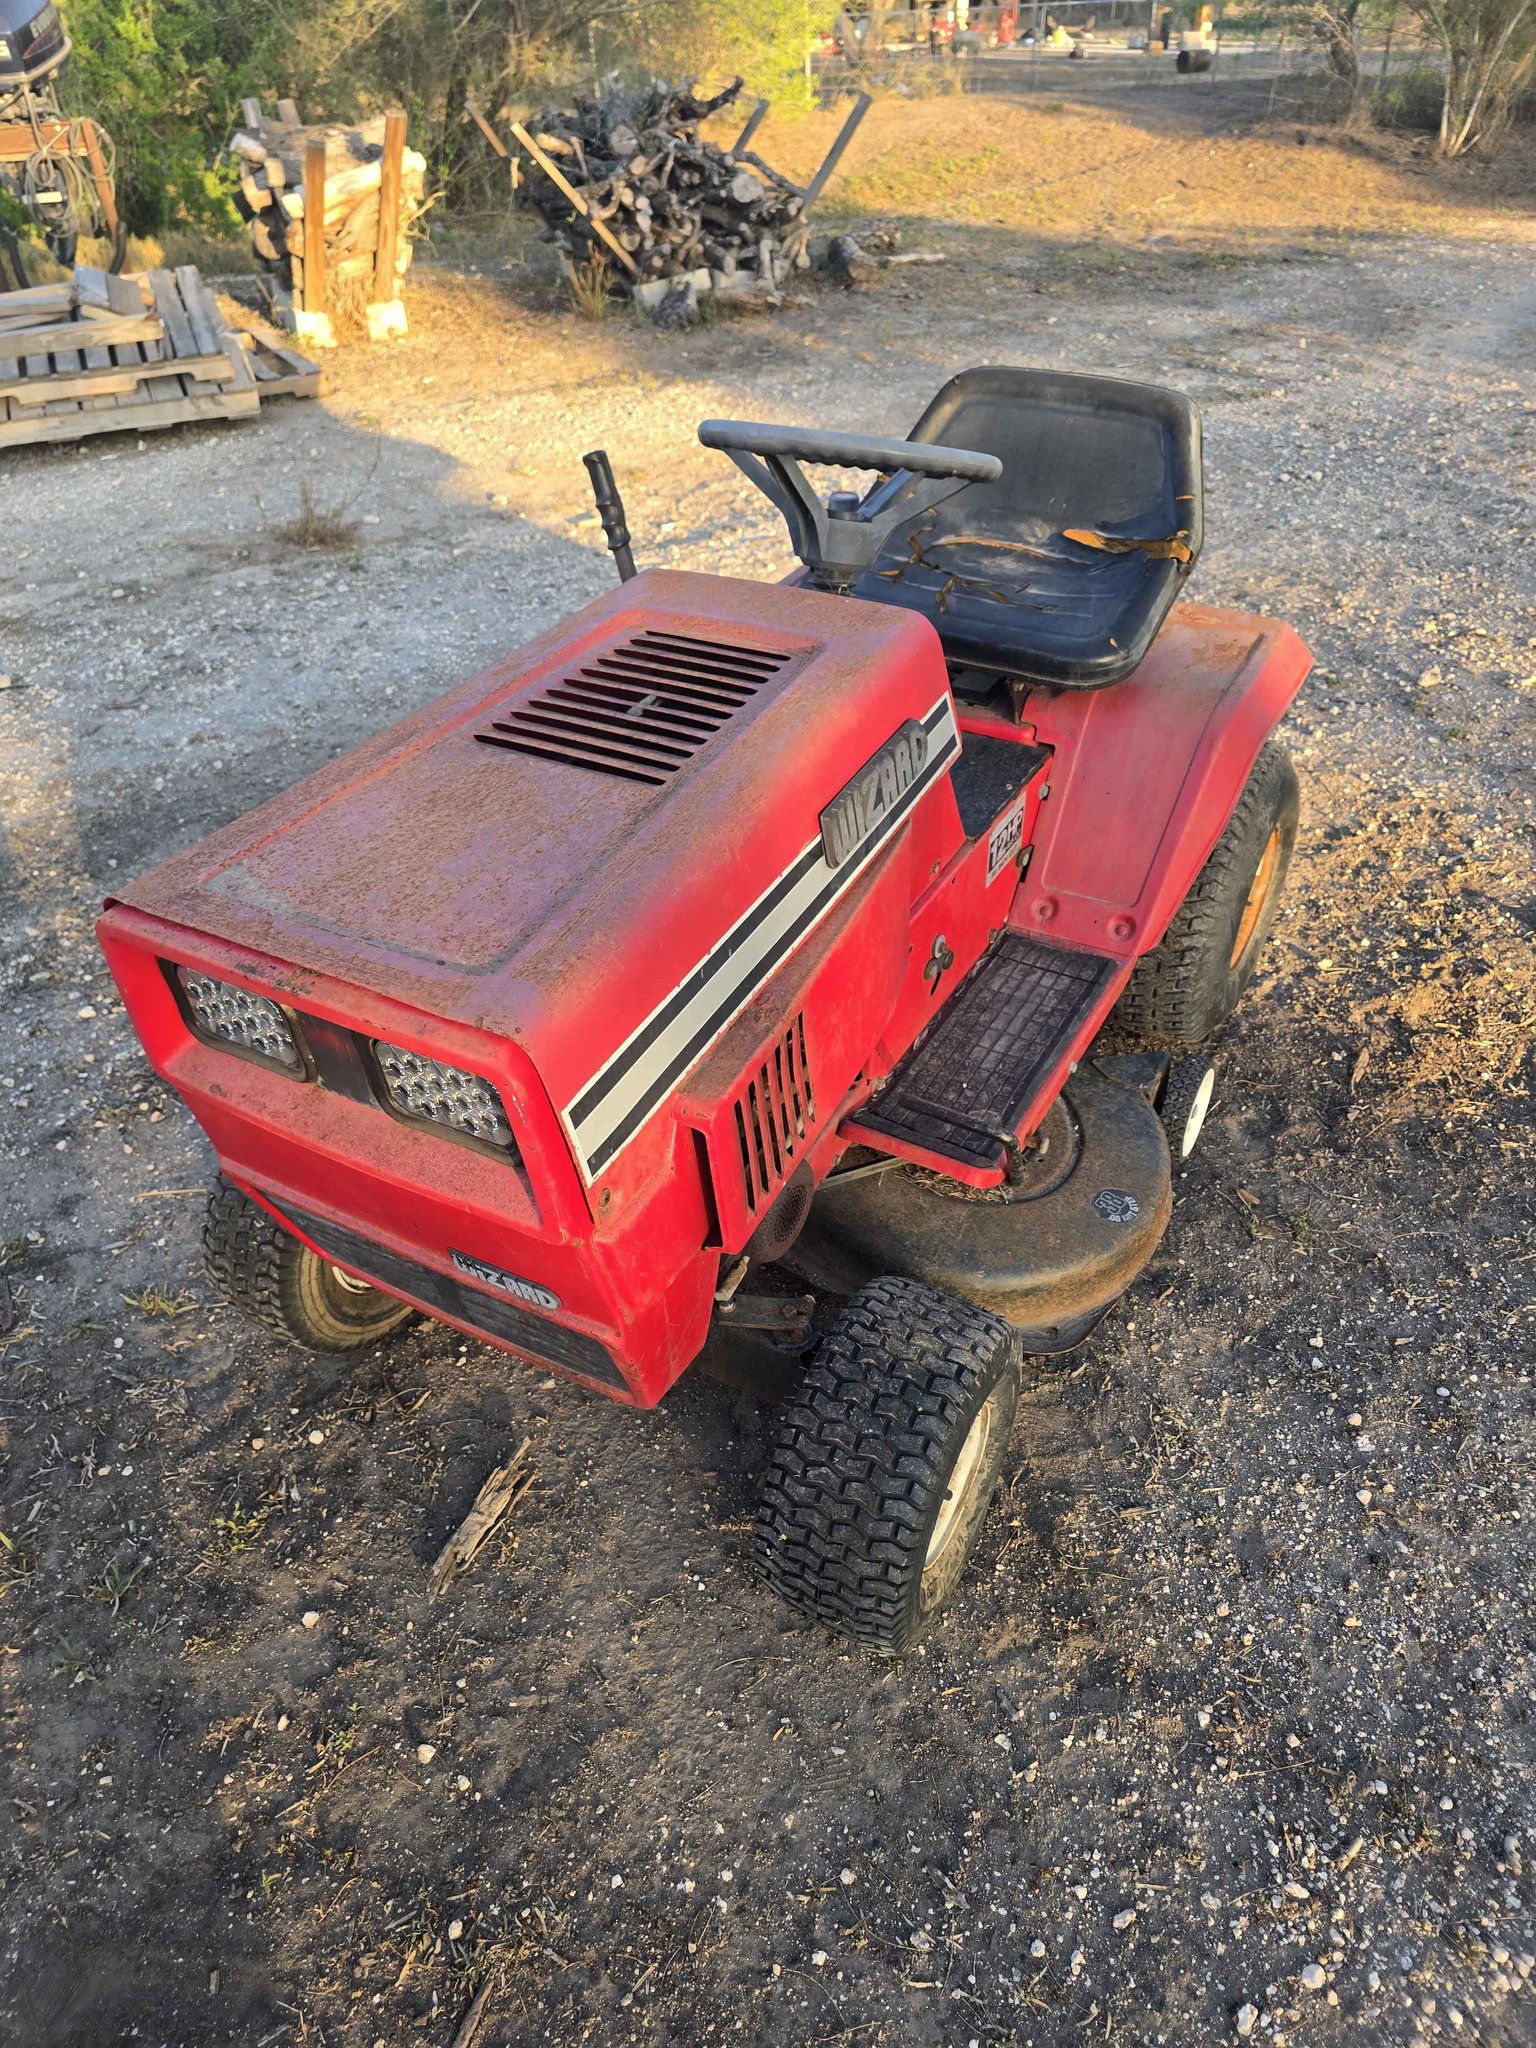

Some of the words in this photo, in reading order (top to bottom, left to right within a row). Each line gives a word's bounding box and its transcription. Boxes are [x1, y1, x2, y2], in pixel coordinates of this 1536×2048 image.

[821, 722, 928, 869] WIZARD
[1094, 1191, 1127, 1215] 38
[1124, 1196, 1139, 1212] STEP
[451, 1252, 560, 1310] WIZARD
